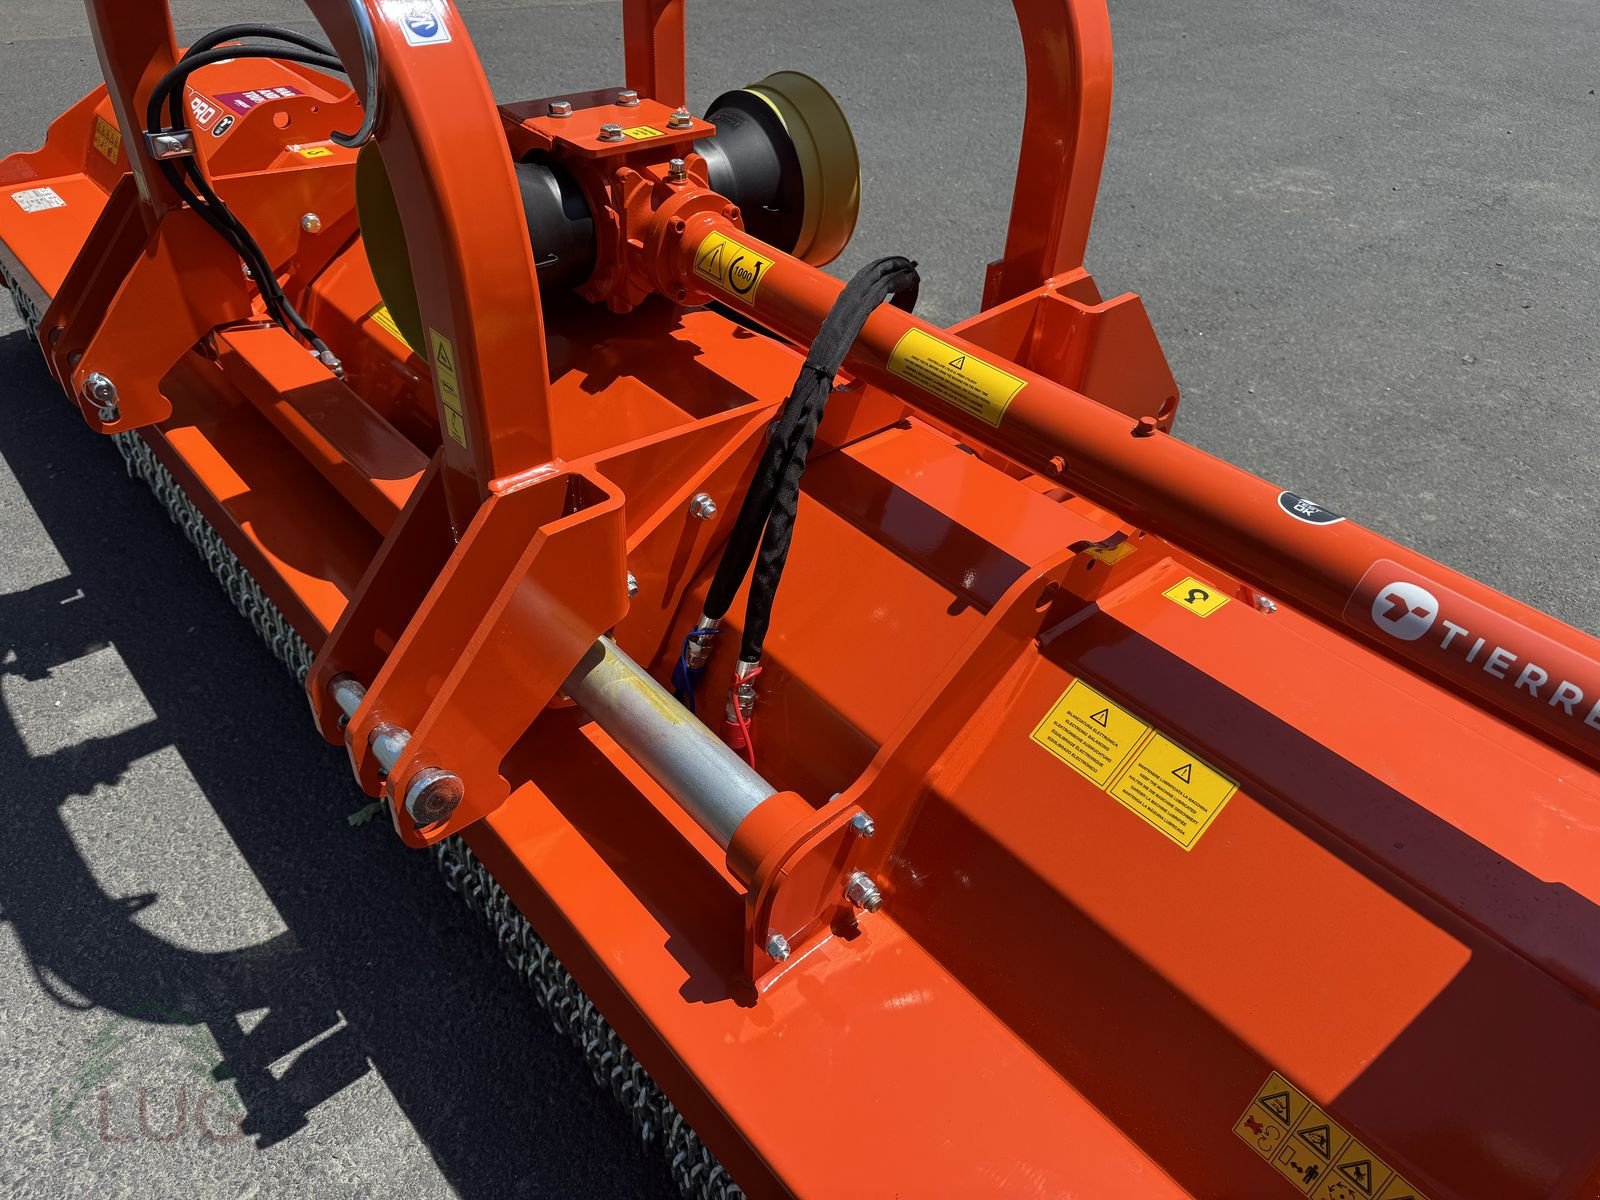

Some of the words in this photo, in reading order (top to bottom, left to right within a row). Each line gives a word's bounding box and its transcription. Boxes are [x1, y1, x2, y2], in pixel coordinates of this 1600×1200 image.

[734, 266, 753, 281] 1000
[1293, 504, 1315, 517] OK
[1297, 500, 1322, 512] TEST
[1064, 719, 1088, 736] ELECTRONIC
[1087, 734, 1109, 751] BALANCING
[1128, 774, 1143, 786] HALTEN
[1154, 793, 1174, 808] MASCHINE
[1130, 785, 1146, 797] GARDER
[1150, 799, 1167, 812] MACHINE
[1138, 772, 1150, 781] KEEP
[1156, 784, 1173, 798] MACHINE
[1172, 796, 1197, 814] LUBRICATED
[1187, 796, 1208, 812] MACCHINA
